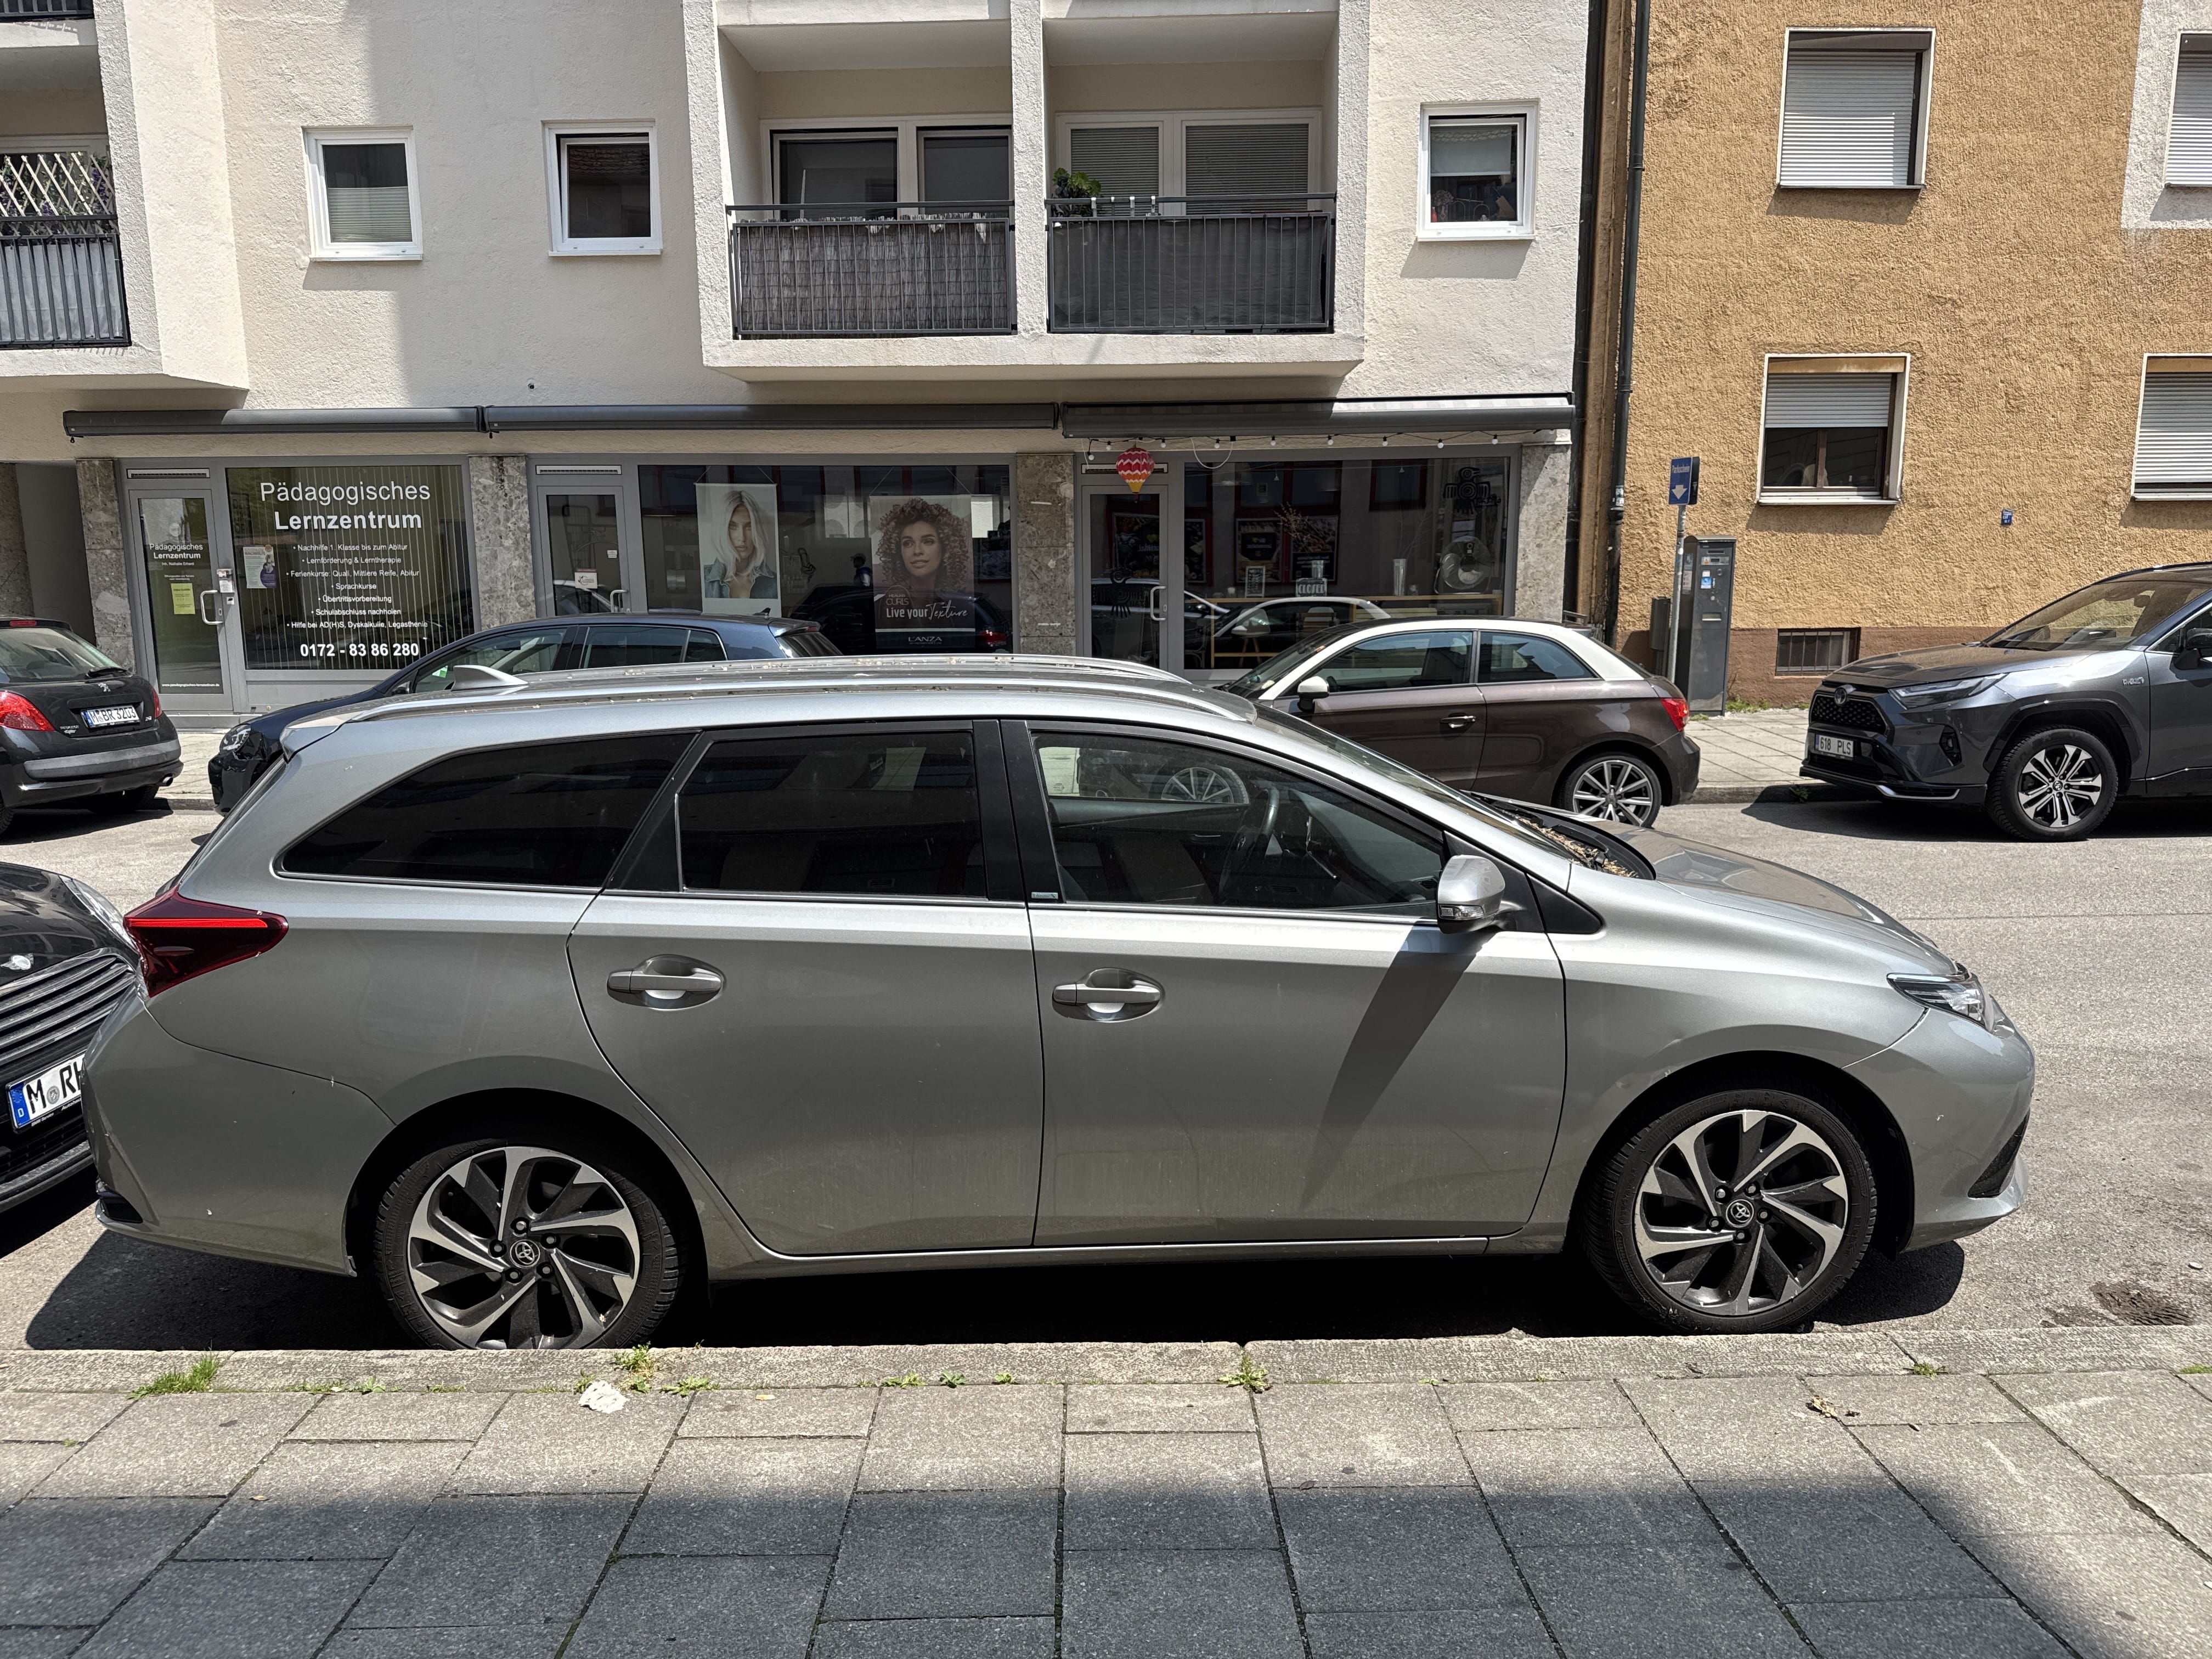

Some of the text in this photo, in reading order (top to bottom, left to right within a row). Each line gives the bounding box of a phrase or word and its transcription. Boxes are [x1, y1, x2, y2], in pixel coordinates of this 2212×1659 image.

[260, 481, 431, 505] Pädagogisches
[274, 511, 422, 530] Lernzentrum
[149, 543, 203, 552] Pädagogisches
[306, 557, 352, 565] Lernförderung
[335, 583, 377, 591] Sprachkurse
[1298, 584, 1325, 594] CLOSED
[322, 595, 392, 603] Übertrittsvorbereitung
[886, 600, 968, 620] Live your Texture
[319, 621, 346, 629] AD(H)S,
[348, 621, 386, 629] Dyskalkulie,
[388, 620, 428, 629] Legasthenie
[300, 644, 335, 657] 0172
[349, 644, 366, 657] 83
[371, 644, 388, 657] 86
[393, 643, 419, 656] 280
[89, 711, 99, 723] M
[103, 709, 116, 721] BR
[116, 707, 137, 720] 3203
[1820, 737, 1852, 755] 618 PLS
[26, 1079, 47, 1114] M
[18, 1108, 25, 1118] D
